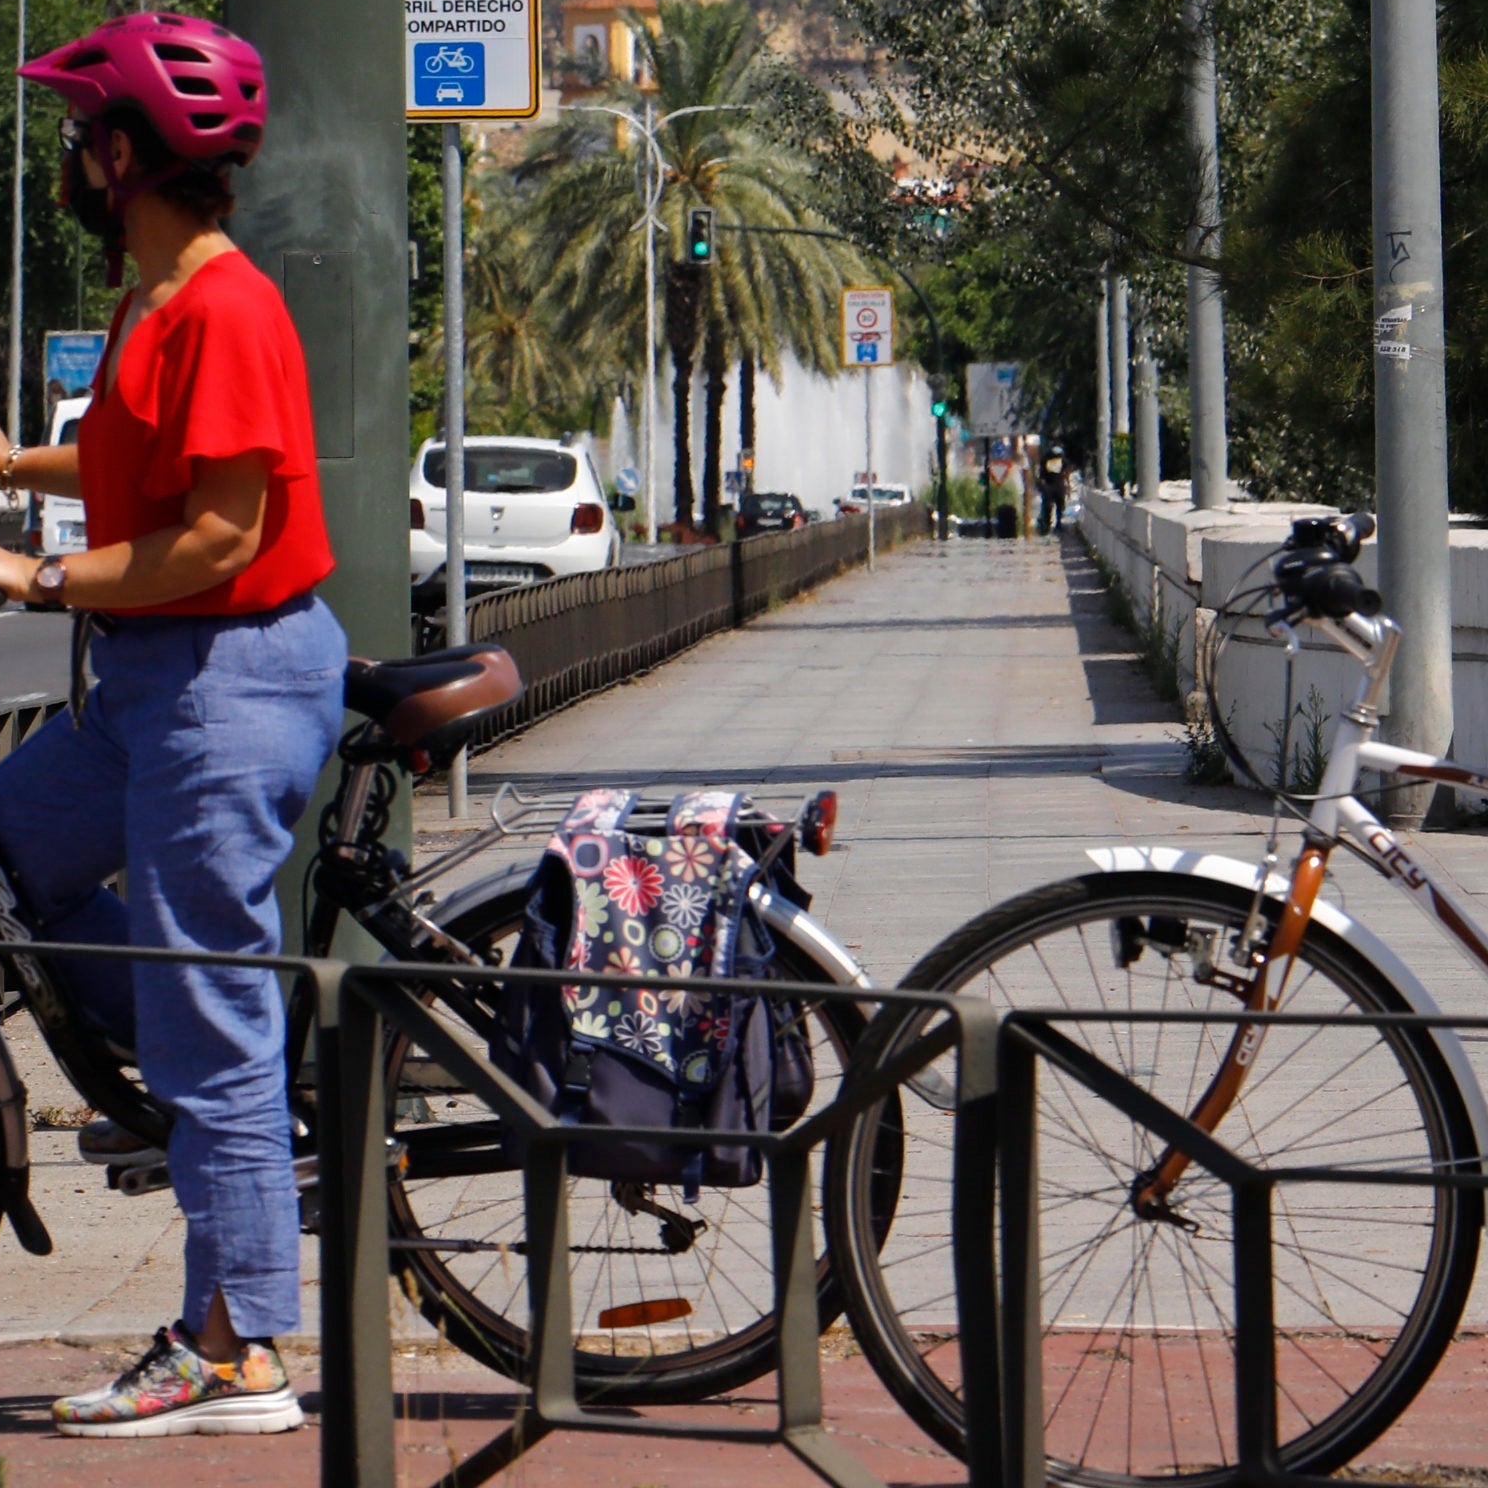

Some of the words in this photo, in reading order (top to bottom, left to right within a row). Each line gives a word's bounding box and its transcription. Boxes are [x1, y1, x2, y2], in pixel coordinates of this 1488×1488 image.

[404, 0, 438, 13] RRIL
[442, 0, 525, 13] DERECHO
[405, 19, 507, 33] OMPARTIDO
